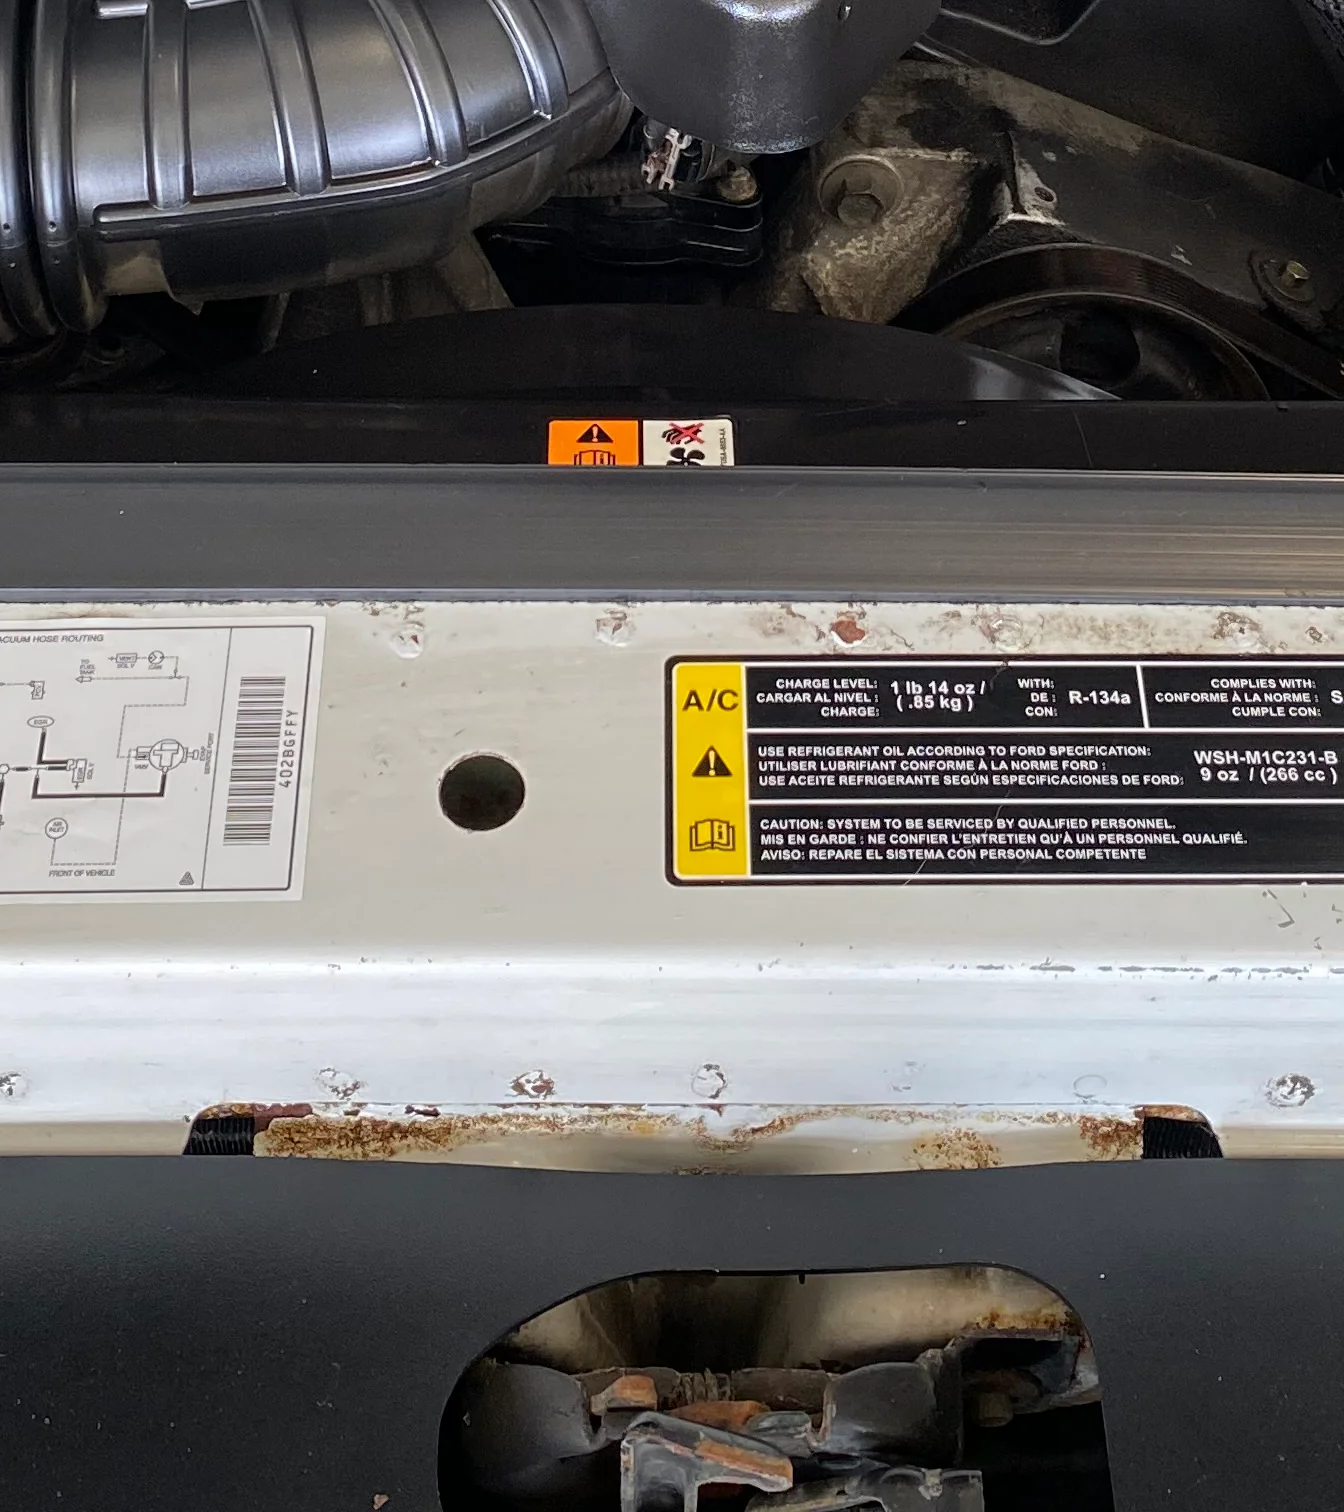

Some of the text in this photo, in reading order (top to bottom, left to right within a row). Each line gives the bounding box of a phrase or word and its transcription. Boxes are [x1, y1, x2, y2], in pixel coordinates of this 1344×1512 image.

[775, 678, 829, 688] CHARGE
[1210, 678, 1276, 688] COMPLIES
[682, 689, 739, 712] A/C
[1068, 690, 1130, 704] R-134a
[758, 746, 784, 756] USE
[787, 745, 879, 756] REFRIGERANT
[882, 745, 904, 756] OIL
[906, 745, 985, 756] ACCORDING
[987, 745, 1006, 755] TO
[1009, 745, 1045, 755] FORD
[1193, 750, 1337, 764] WSH-M1C231-B
[827, 818, 880, 829] SYSTEM
[883, 818, 901, 829] TO
[905, 818, 923, 829] BE
[926, 818, 992, 830] SERVICED
[996, 818, 1014, 828] BY
[1017, 818, 1087, 829] QUALIFIED
[1091, 818, 1175, 829] PERSONNEL.
